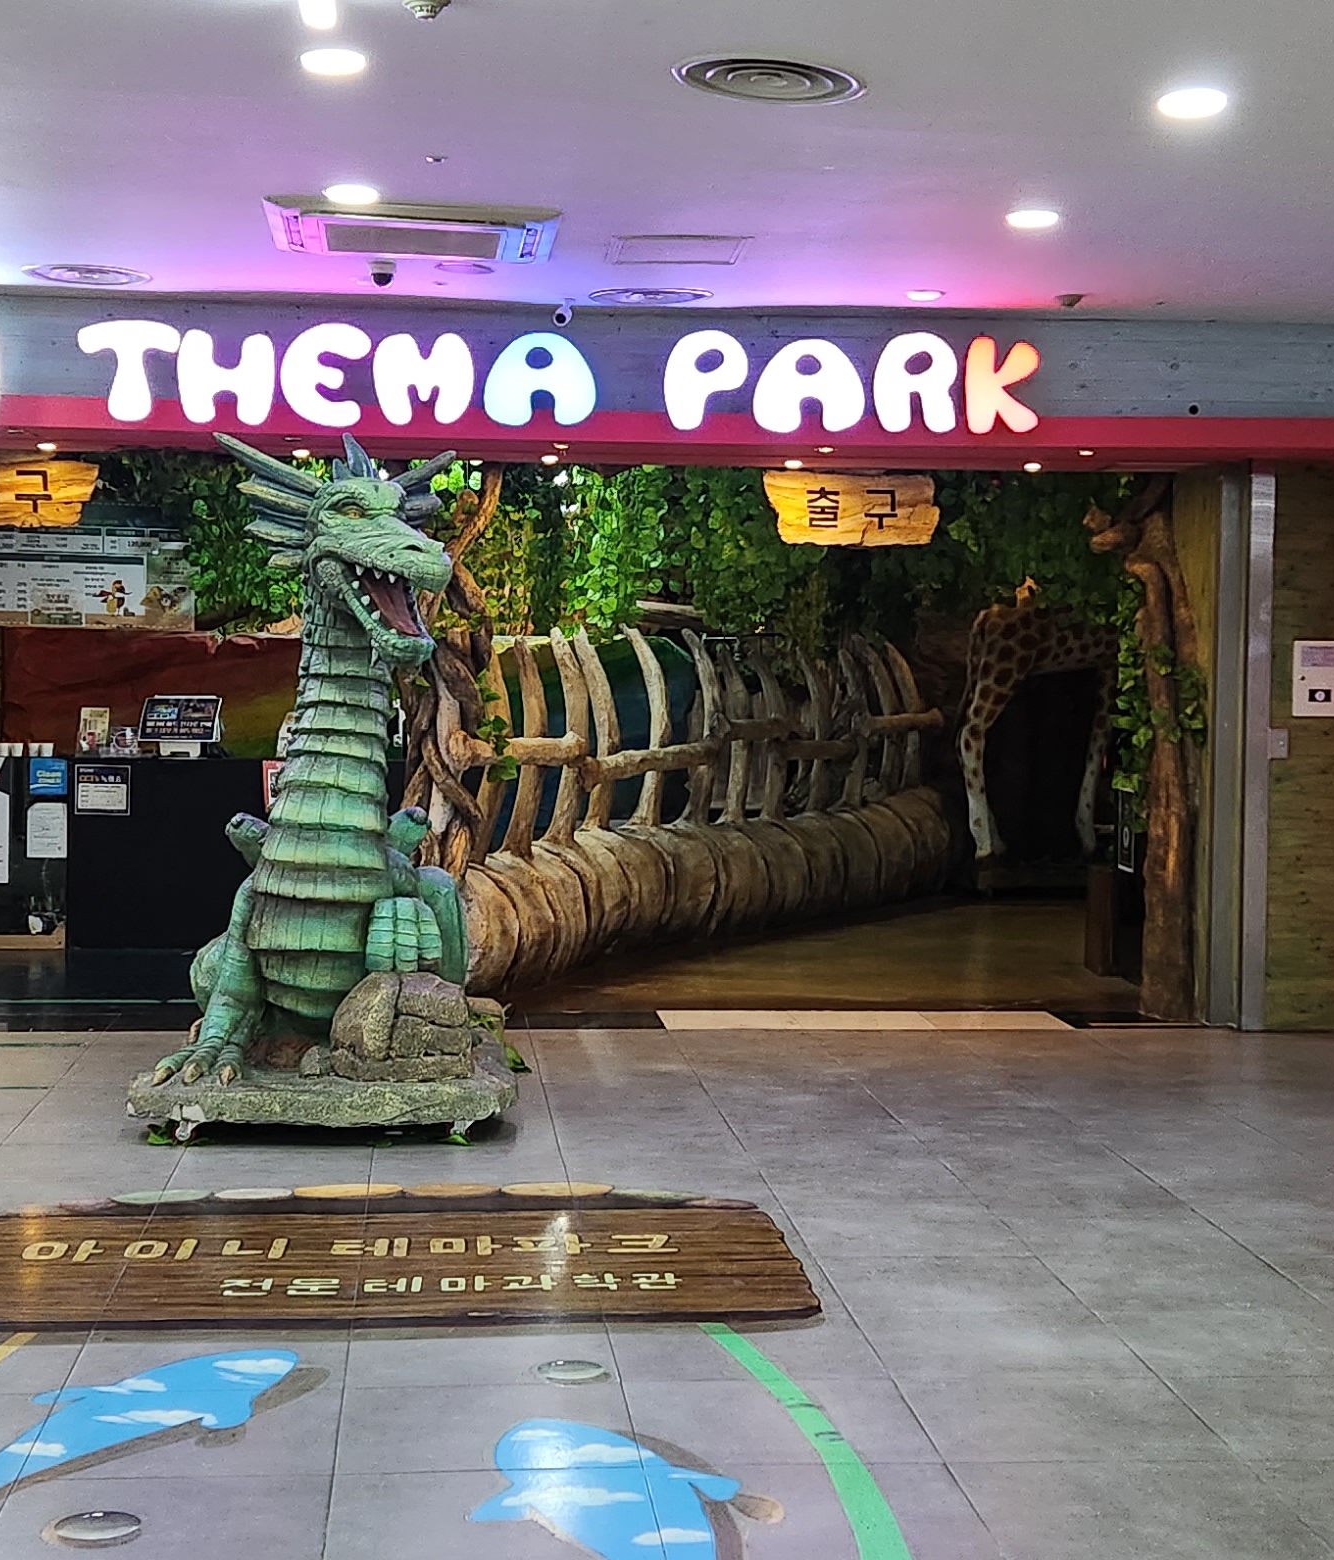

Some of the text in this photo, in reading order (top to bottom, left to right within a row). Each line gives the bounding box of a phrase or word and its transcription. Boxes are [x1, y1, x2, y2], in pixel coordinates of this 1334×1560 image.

[76, 319, 597, 428] THEMA
[663, 329, 1041, 434] PARK
[805, 486, 899, 530] 출구
[21, 1233, 680, 1262] 아이니 테마파크
